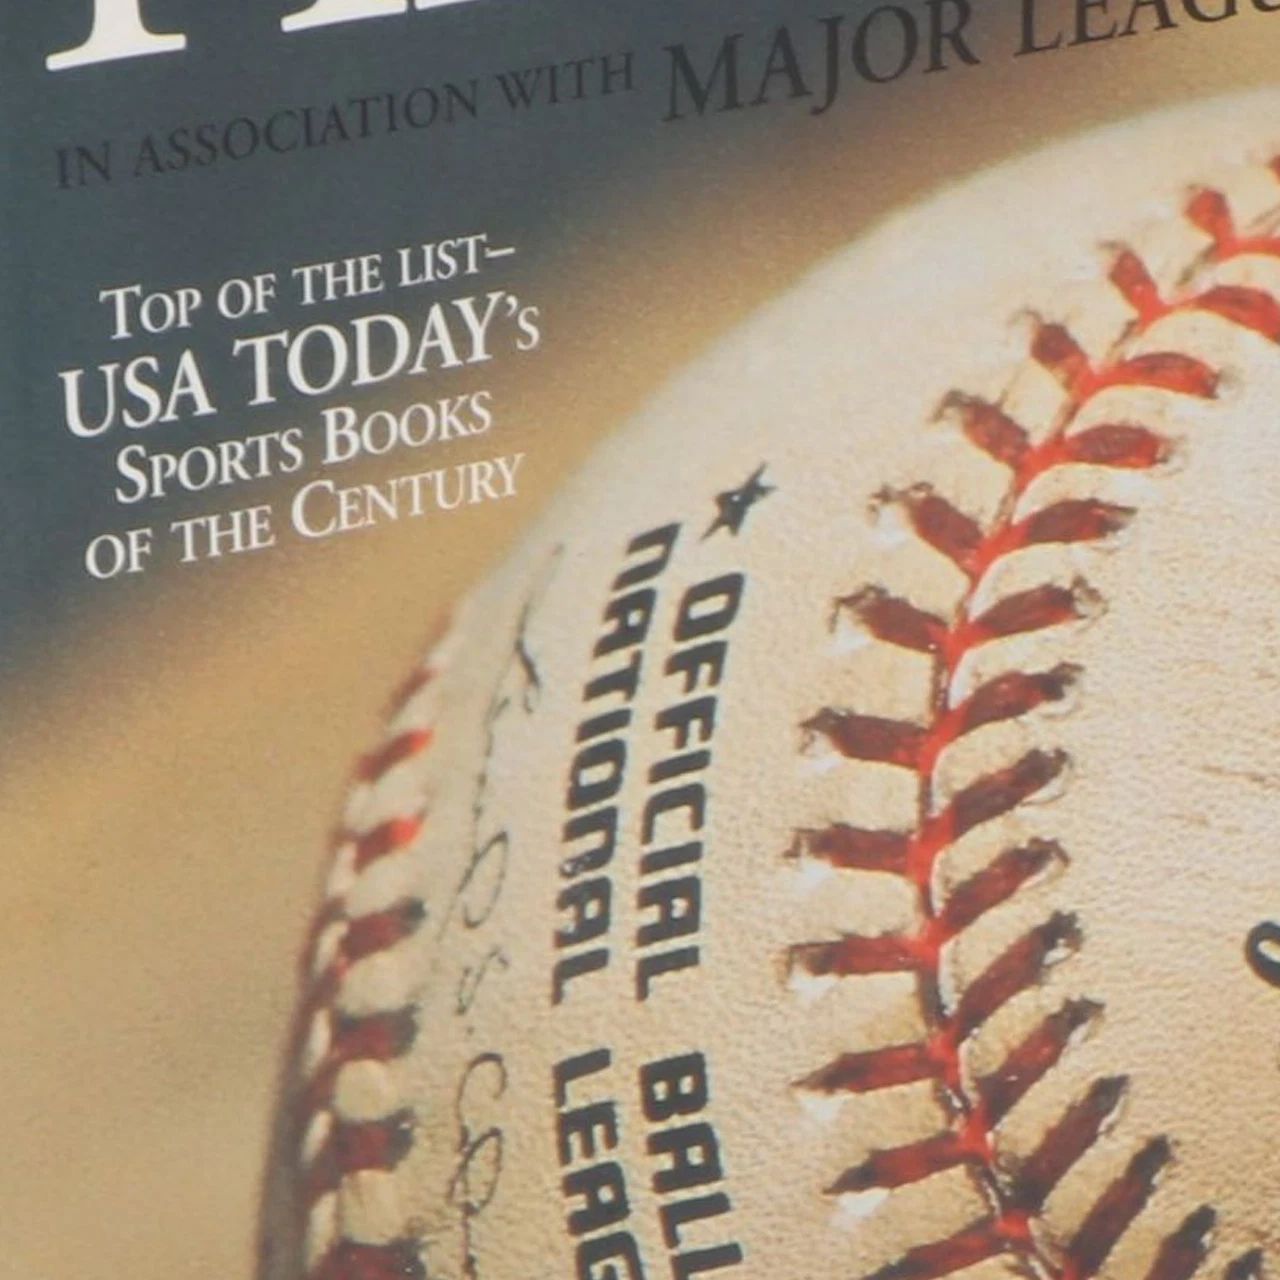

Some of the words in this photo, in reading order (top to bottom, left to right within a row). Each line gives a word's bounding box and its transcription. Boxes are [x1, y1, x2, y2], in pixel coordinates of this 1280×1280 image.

[54, 142, 113, 191] IN
[132, 79, 479, 179] ASSOCIATION
[495, 51, 637, 110] WITH
[99, 284, 201, 340] TOP
[217, 273, 277, 320] OF
[292, 253, 383, 306] THE
[58, 348, 216, 438] USA
[115, 427, 303, 504] SPORTS
[321, 390, 493, 465] BOOKS
[85, 528, 152, 579] OF
[171, 505, 276, 563] THE
[291, 452, 526, 538] CENTURY
[551, 523, 682, 1006] NATIONAL
[635, 572, 745, 1002] OFFICIAL
